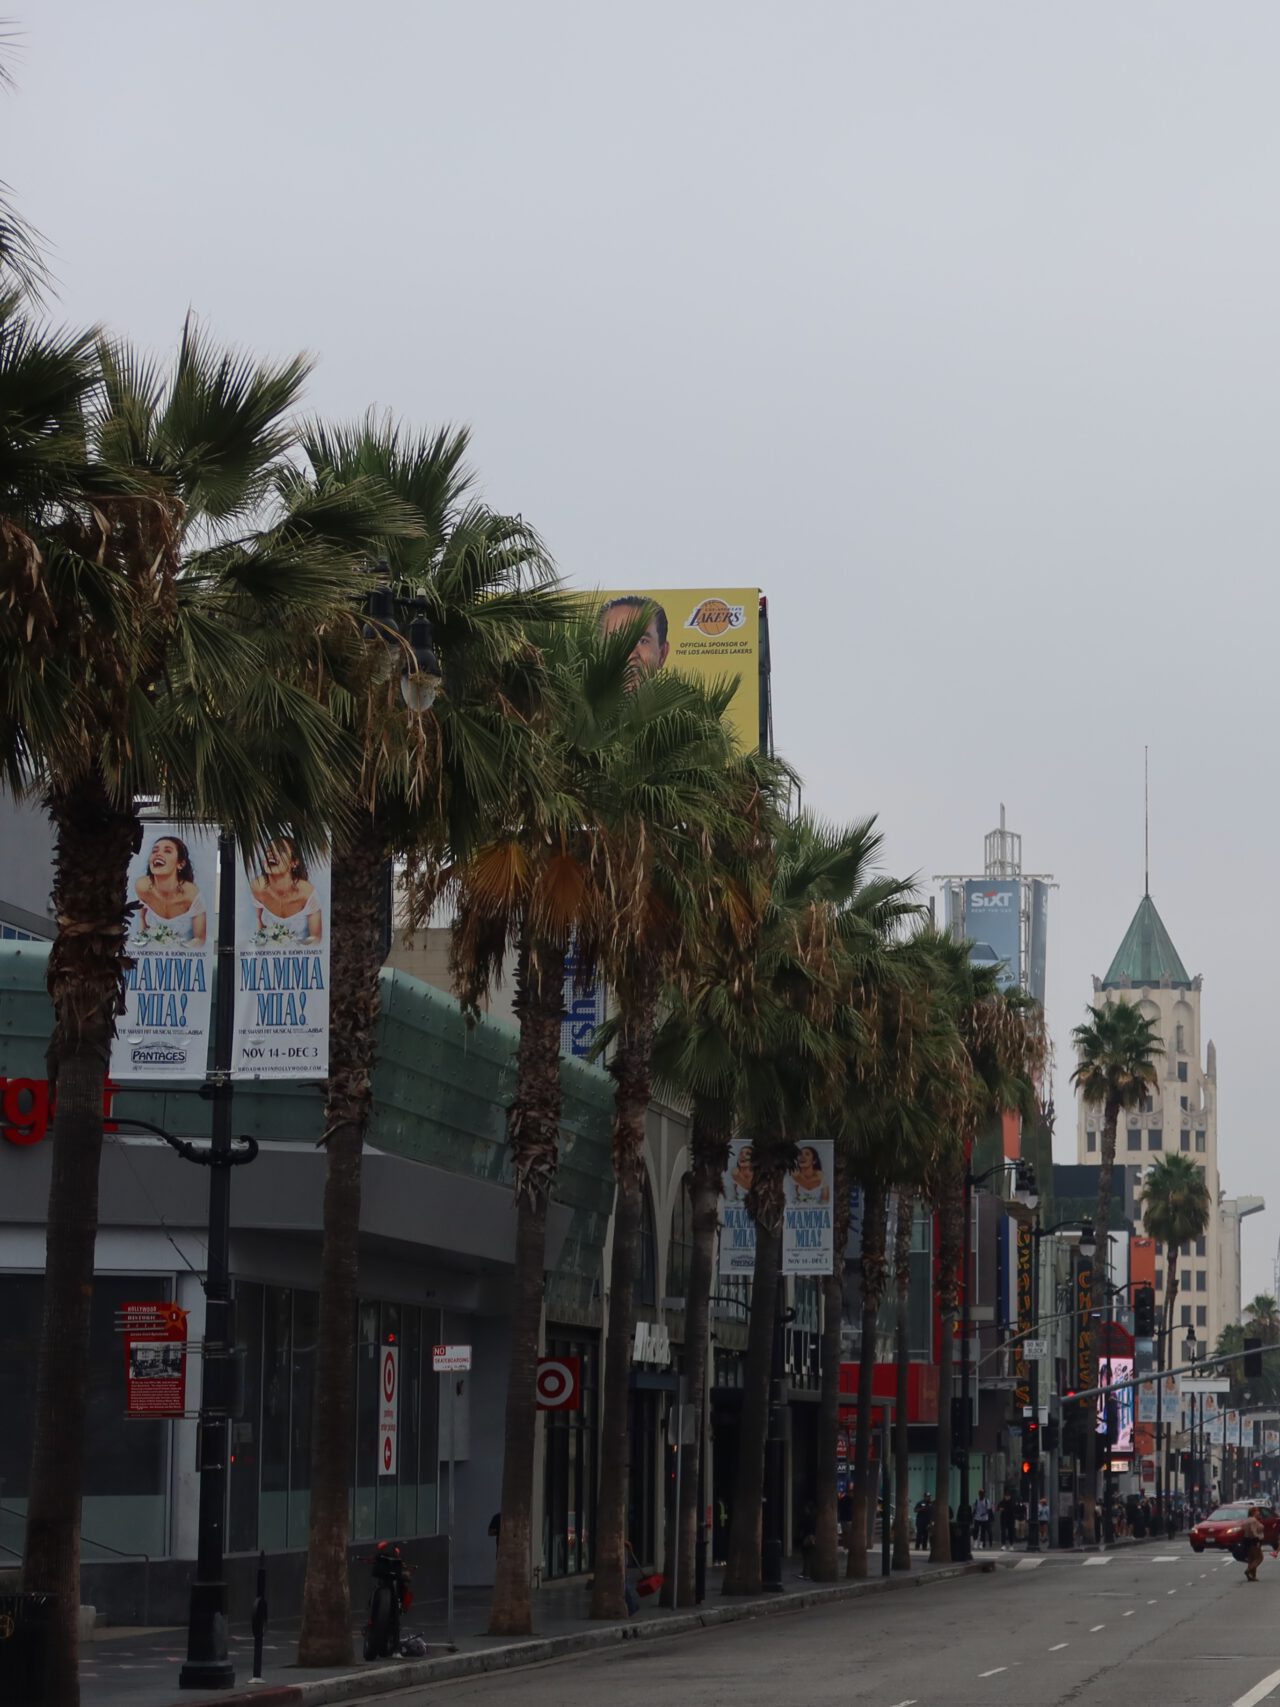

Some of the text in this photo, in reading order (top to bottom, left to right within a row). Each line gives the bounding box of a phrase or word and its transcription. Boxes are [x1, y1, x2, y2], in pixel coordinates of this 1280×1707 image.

[688, 608, 742, 627] LAKERS
[240, 956, 324, 992] MAMMA
[136, 993, 188, 1027] MIA!
[256, 991, 307, 1027] MIA!
[132, 1050, 186, 1061] PANTAGES
[242, 1047, 265, 1059] NOV
[269, 1047, 279, 1058] 14
[288, 1047, 309, 1058] DEC
[311, 1046, 318, 1057] 3
[785, 1210, 831, 1230] MAMMA
[795, 1230, 822, 1249] MIA!
[434, 1347, 446, 1356] NO
